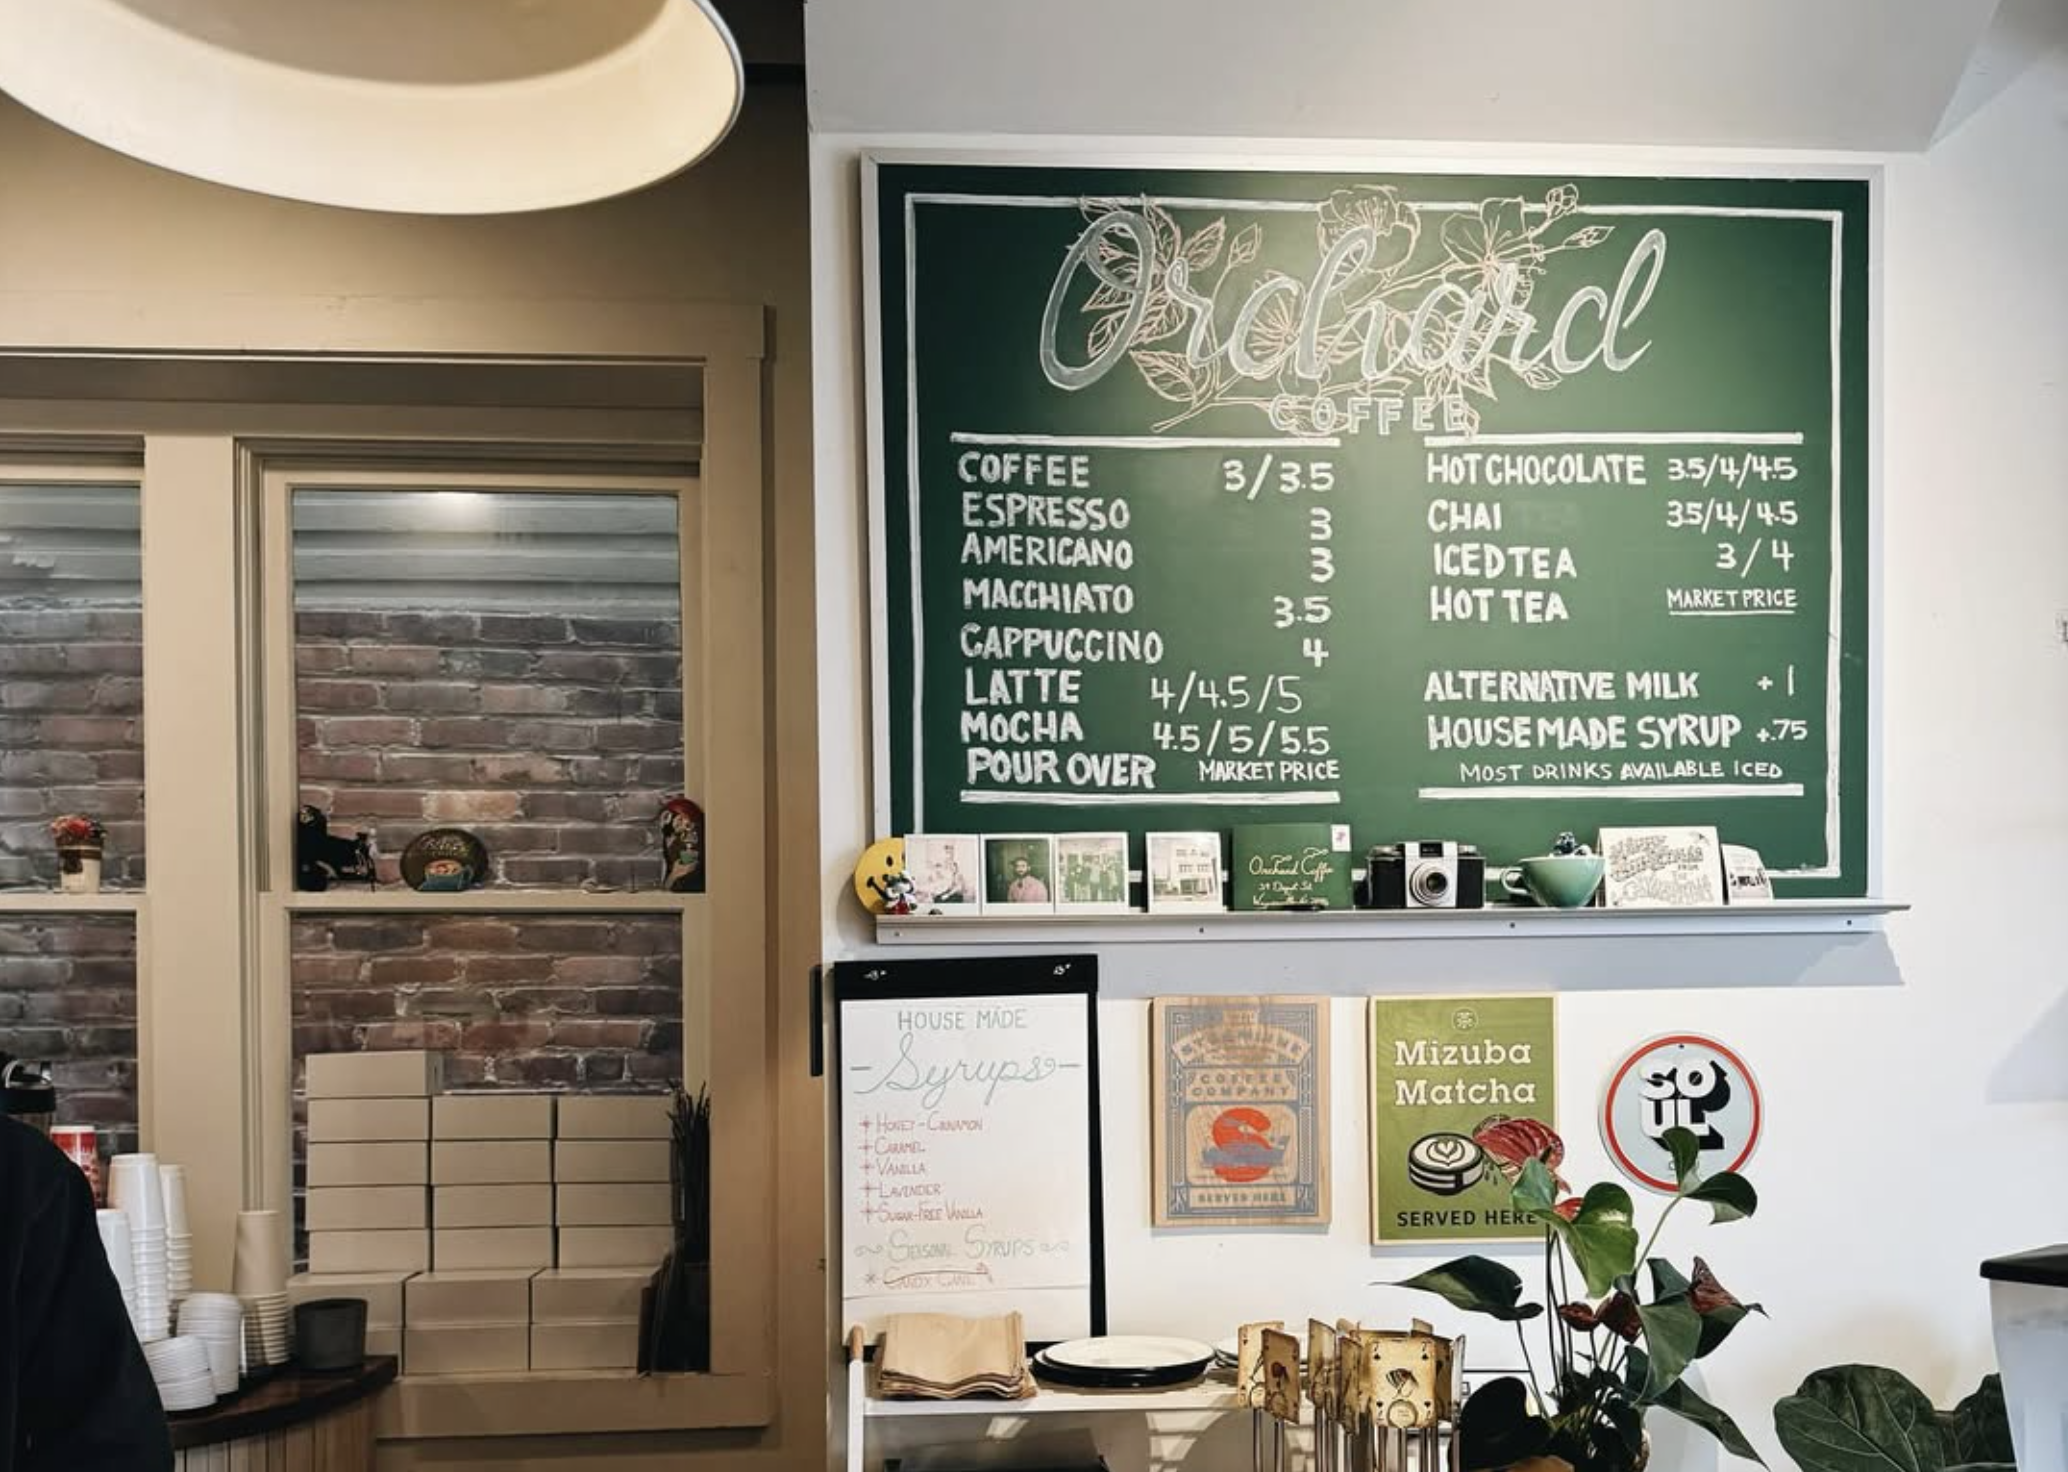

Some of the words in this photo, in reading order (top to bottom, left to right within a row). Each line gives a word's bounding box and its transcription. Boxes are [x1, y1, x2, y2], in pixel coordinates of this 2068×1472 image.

[1040, 211, 1666, 390] Orchard
[1269, 398, 1468, 436] COFFEE
[957, 451, 1090, 487] COFFEE
[1427, 453, 1481, 485] HOT
[1485, 453, 1647, 486] CHOCOLATE
[962, 490, 1130, 531] ESPRESSO
[1309, 507, 1333, 541] 3
[1427, 499, 1502, 532] CHAI
[961, 532, 1134, 570] AMERICANO
[1310, 546, 1335, 583] 3
[1433, 543, 1505, 577] ICED
[1507, 546, 1577, 580] TEA
[962, 578, 1135, 615] MACCHIATO
[1274, 595, 1332, 629] 3.5
[1430, 585, 1494, 622] HOT
[1502, 589, 1570, 623] TEA
[1667, 588, 1739, 609] MARKET
[1743, 588, 1798, 609] PRICE
[960, 622, 1165, 664] CAPPUCCINO
[1303, 637, 1329, 667] 4
[965, 668, 1082, 706] LATTE
[1424, 670, 1616, 702] ALTERNATIVE
[1627, 670, 1700, 699] MILK
[961, 710, 1084, 744] MOCHA
[1428, 714, 1532, 750] HOUSE
[1538, 715, 1627, 750] MADE
[1637, 713, 1742, 750] SYRUP
[967, 747, 1062, 785] POUR
[1066, 752, 1156, 789] OVER
[1200, 760, 1274, 782] MARKET
[1280, 759, 1340, 781] PRICE
[1460, 763, 1523, 783] MOST
[1533, 760, 1612, 781] DRINKS
[1620, 760, 1725, 781] AVAILABLE
[1734, 761, 1783, 779] ICED
[897, 1010, 965, 1031] HOUSE
[976, 1008, 1028, 1030] MADE
[1395, 1039, 1531, 1066] Mizuba
[853, 1031, 1056, 1109] Syrups
[1201, 1074, 1283, 1085] COFFEE
[1191, 1086, 1290, 1097] COMPANY
[1395, 1078, 1536, 1106] Matcha
[1397, 1211, 1476, 1227] SERVED
